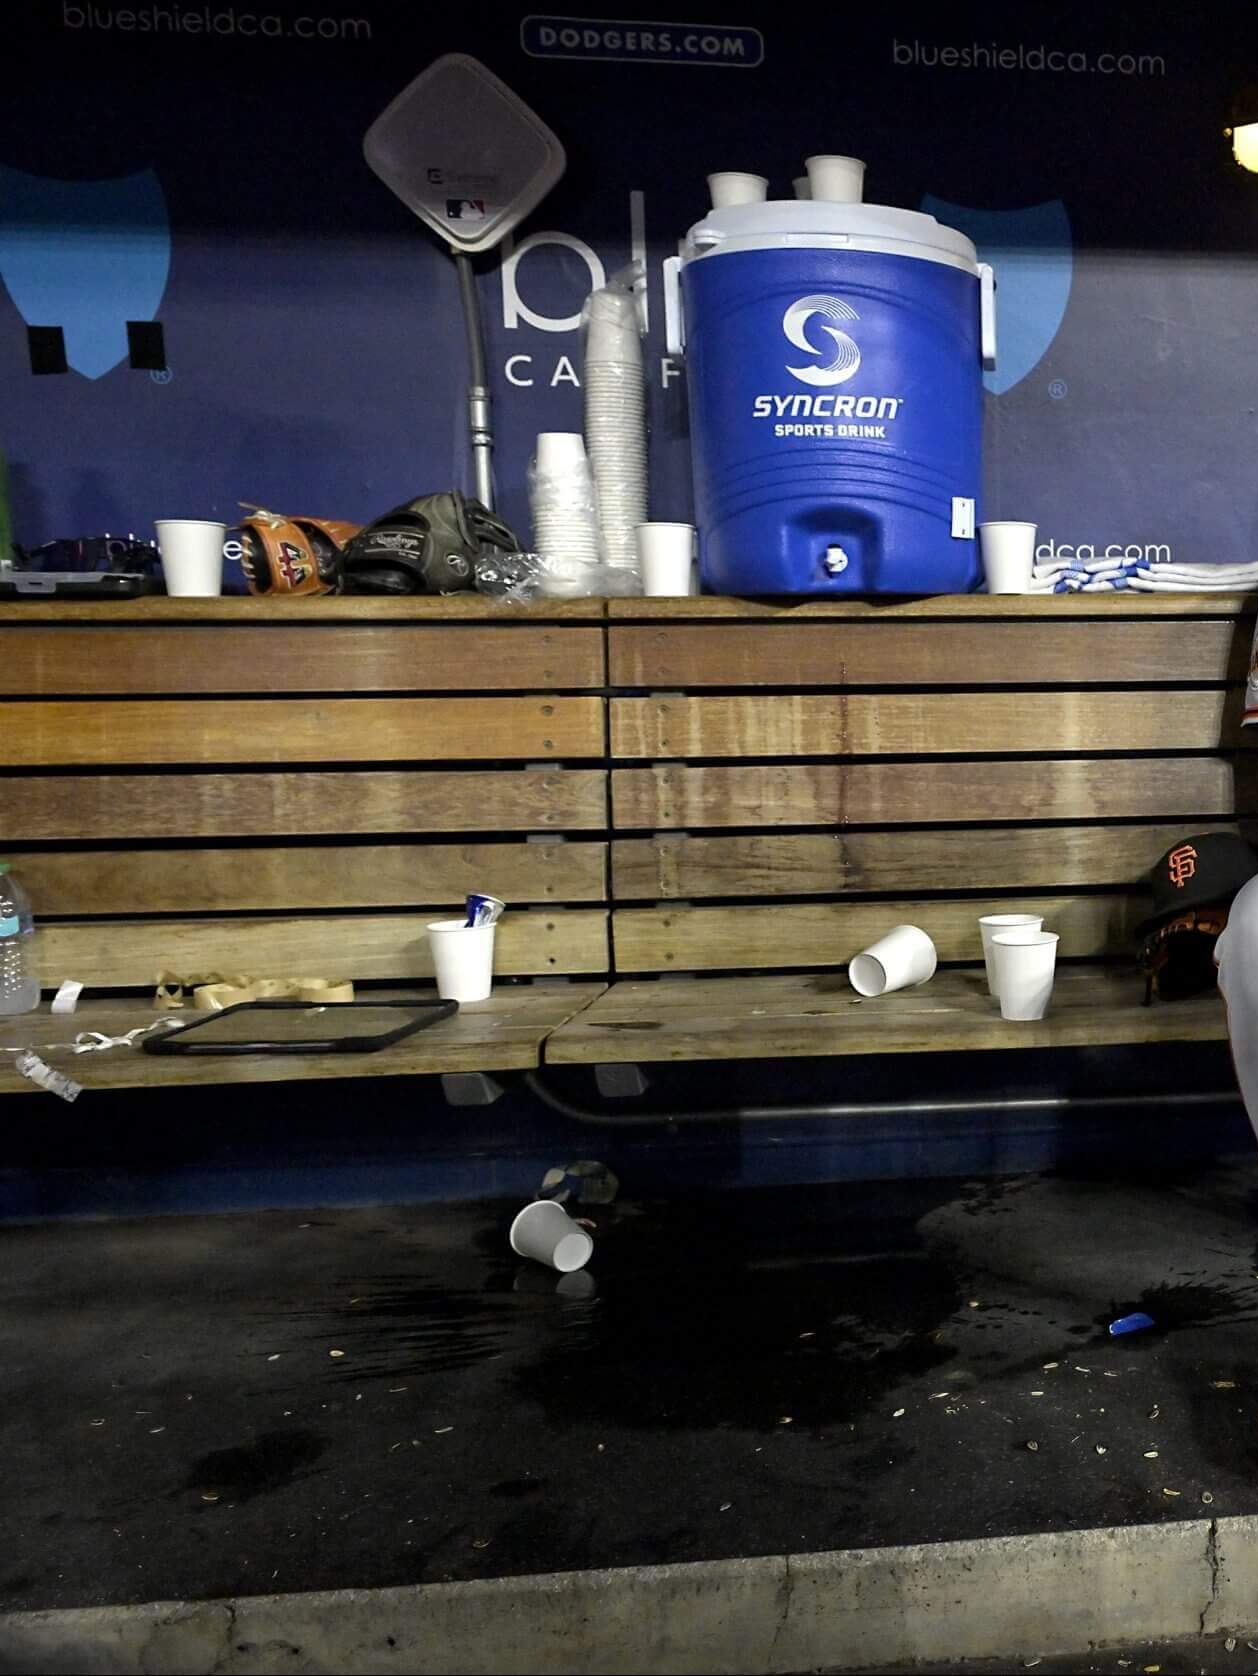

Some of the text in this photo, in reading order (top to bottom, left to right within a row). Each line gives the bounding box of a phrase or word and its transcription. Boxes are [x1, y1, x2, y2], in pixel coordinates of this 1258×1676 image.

[63, 2, 373, 39] blueshieldca.com
[538, 26, 745, 56] DODGERS.COM
[892, 37, 1166, 75] blueshieldca.com
[752, 394, 899, 419] SYNCRON
[774, 423, 886, 438] SPORTS DRINK
